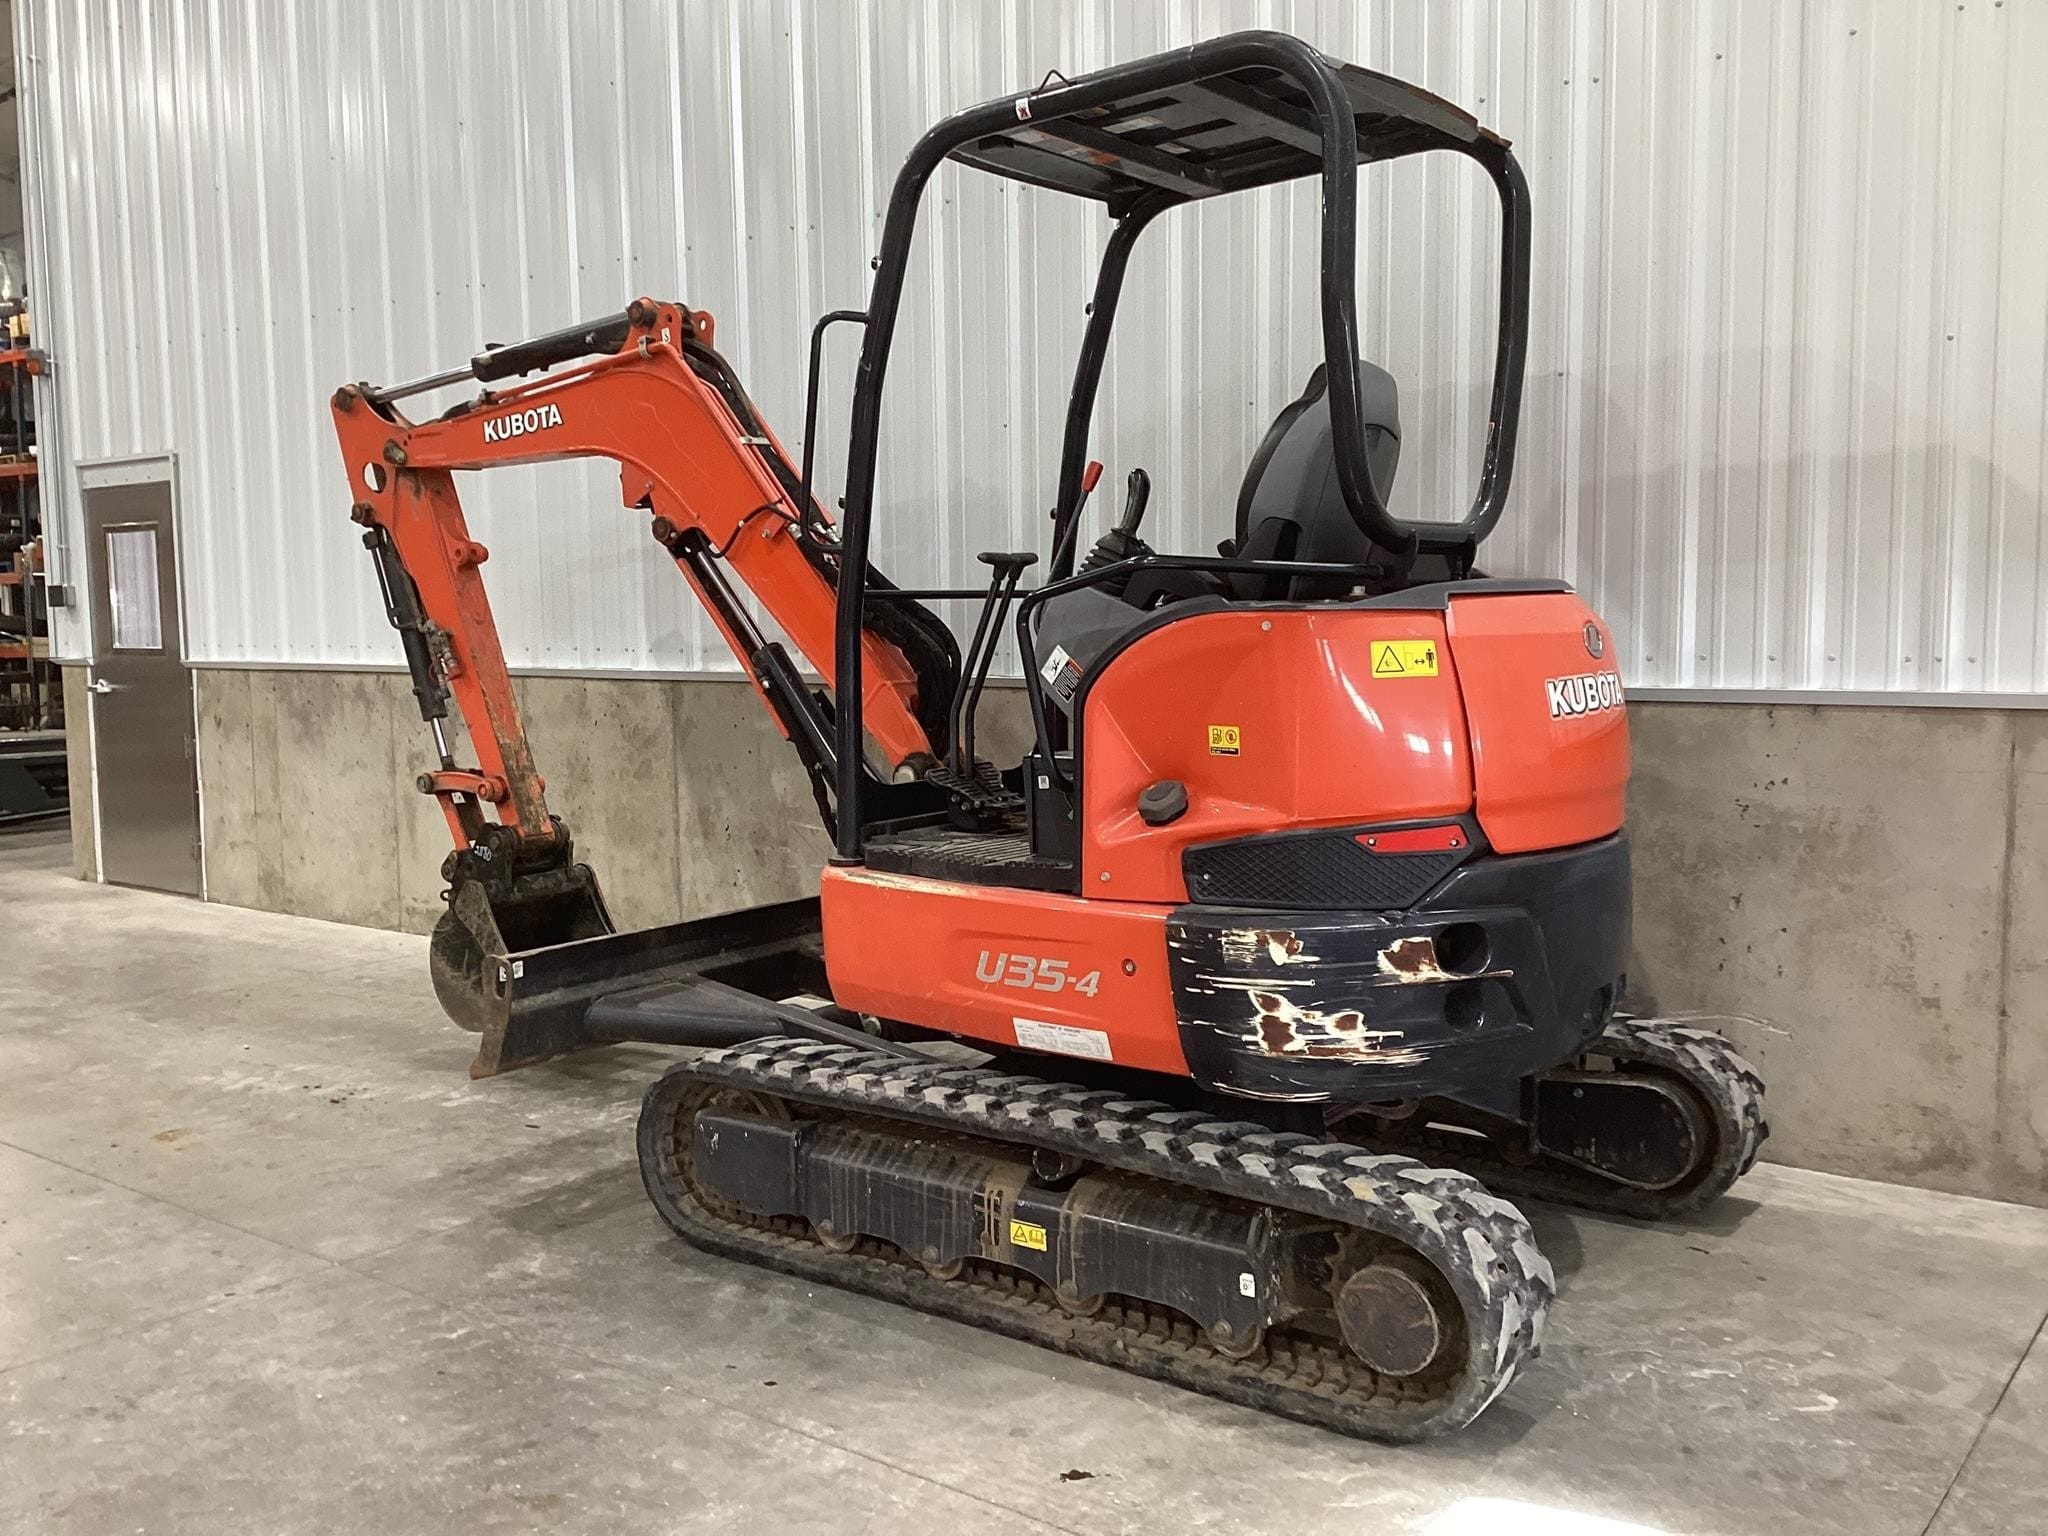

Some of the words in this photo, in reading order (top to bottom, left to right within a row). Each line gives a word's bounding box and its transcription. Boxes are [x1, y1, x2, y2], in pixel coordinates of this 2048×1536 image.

[483, 403, 563, 443] KUBOTA
[1546, 672, 1625, 718] KUBOTA
[975, 950, 1101, 998] U35-4
